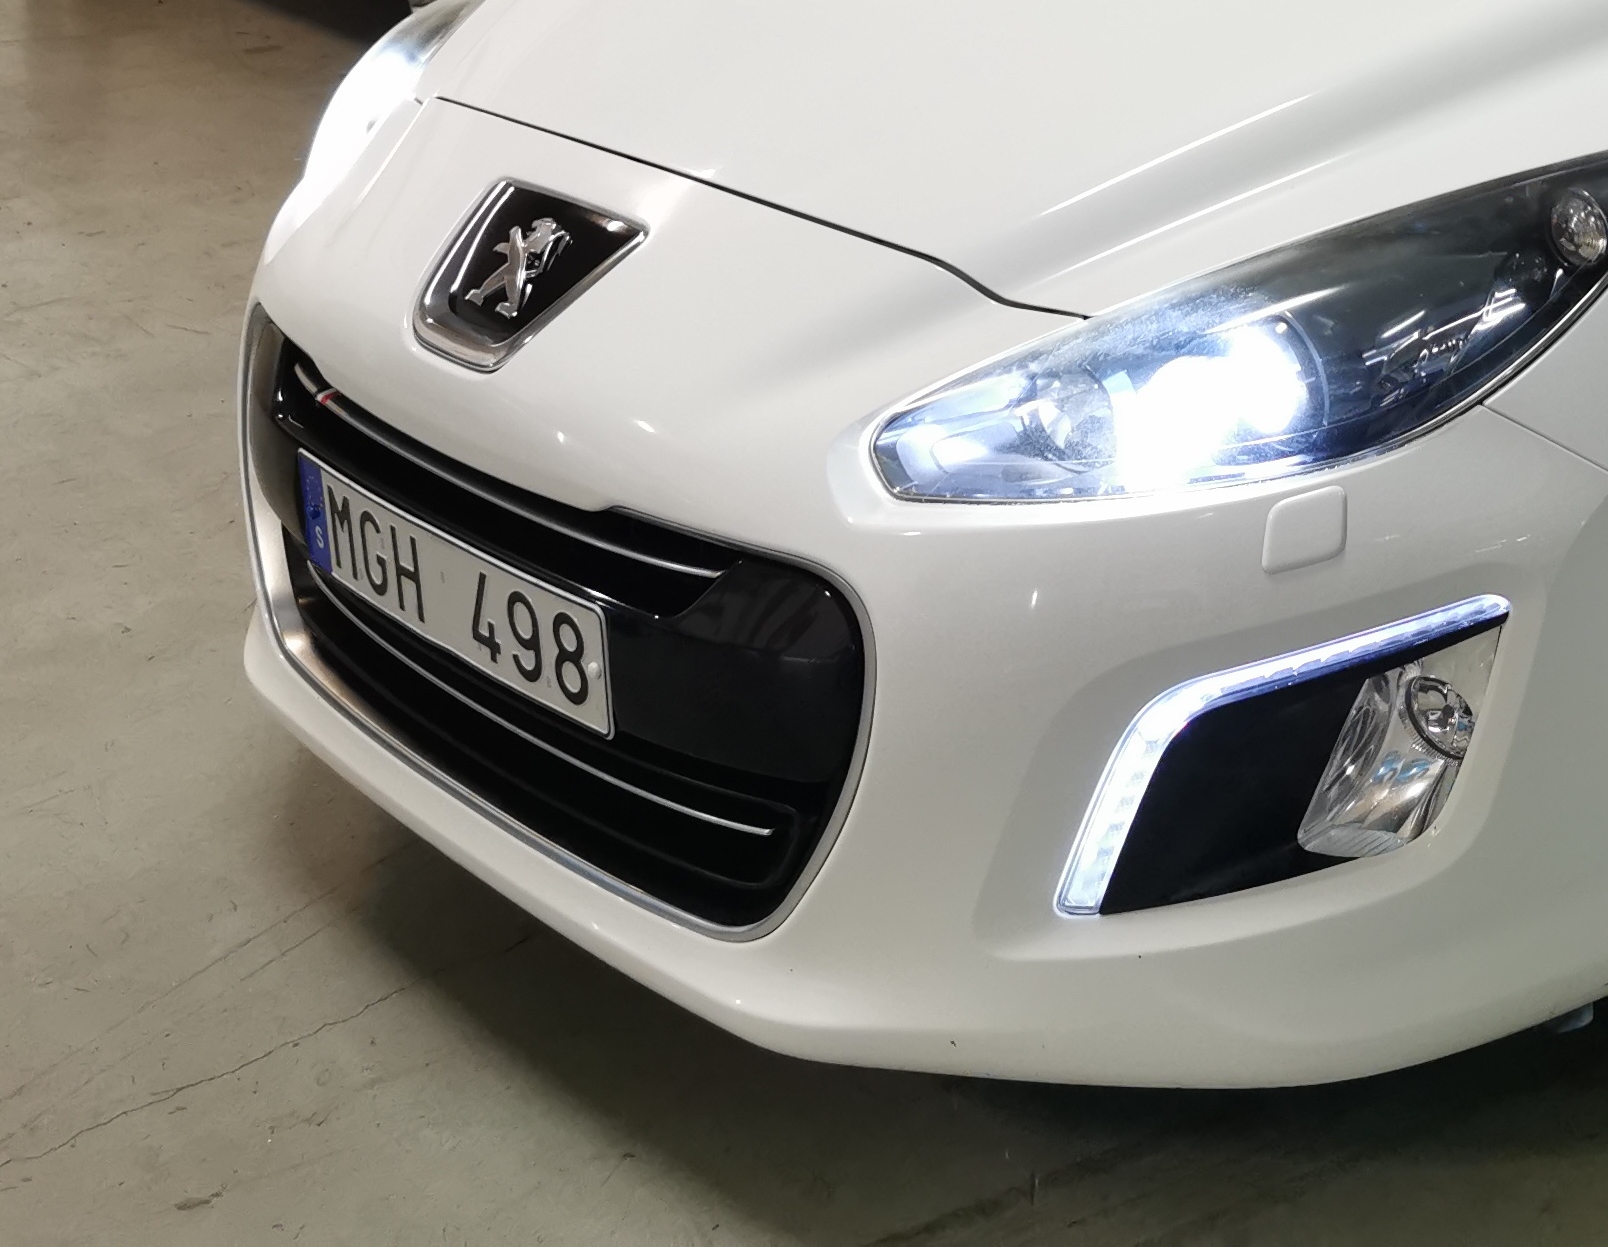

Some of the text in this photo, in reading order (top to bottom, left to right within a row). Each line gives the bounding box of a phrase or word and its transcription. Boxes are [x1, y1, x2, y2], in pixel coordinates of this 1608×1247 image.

[314, 525, 325, 549] S
[327, 484, 590, 706] MGH 498
